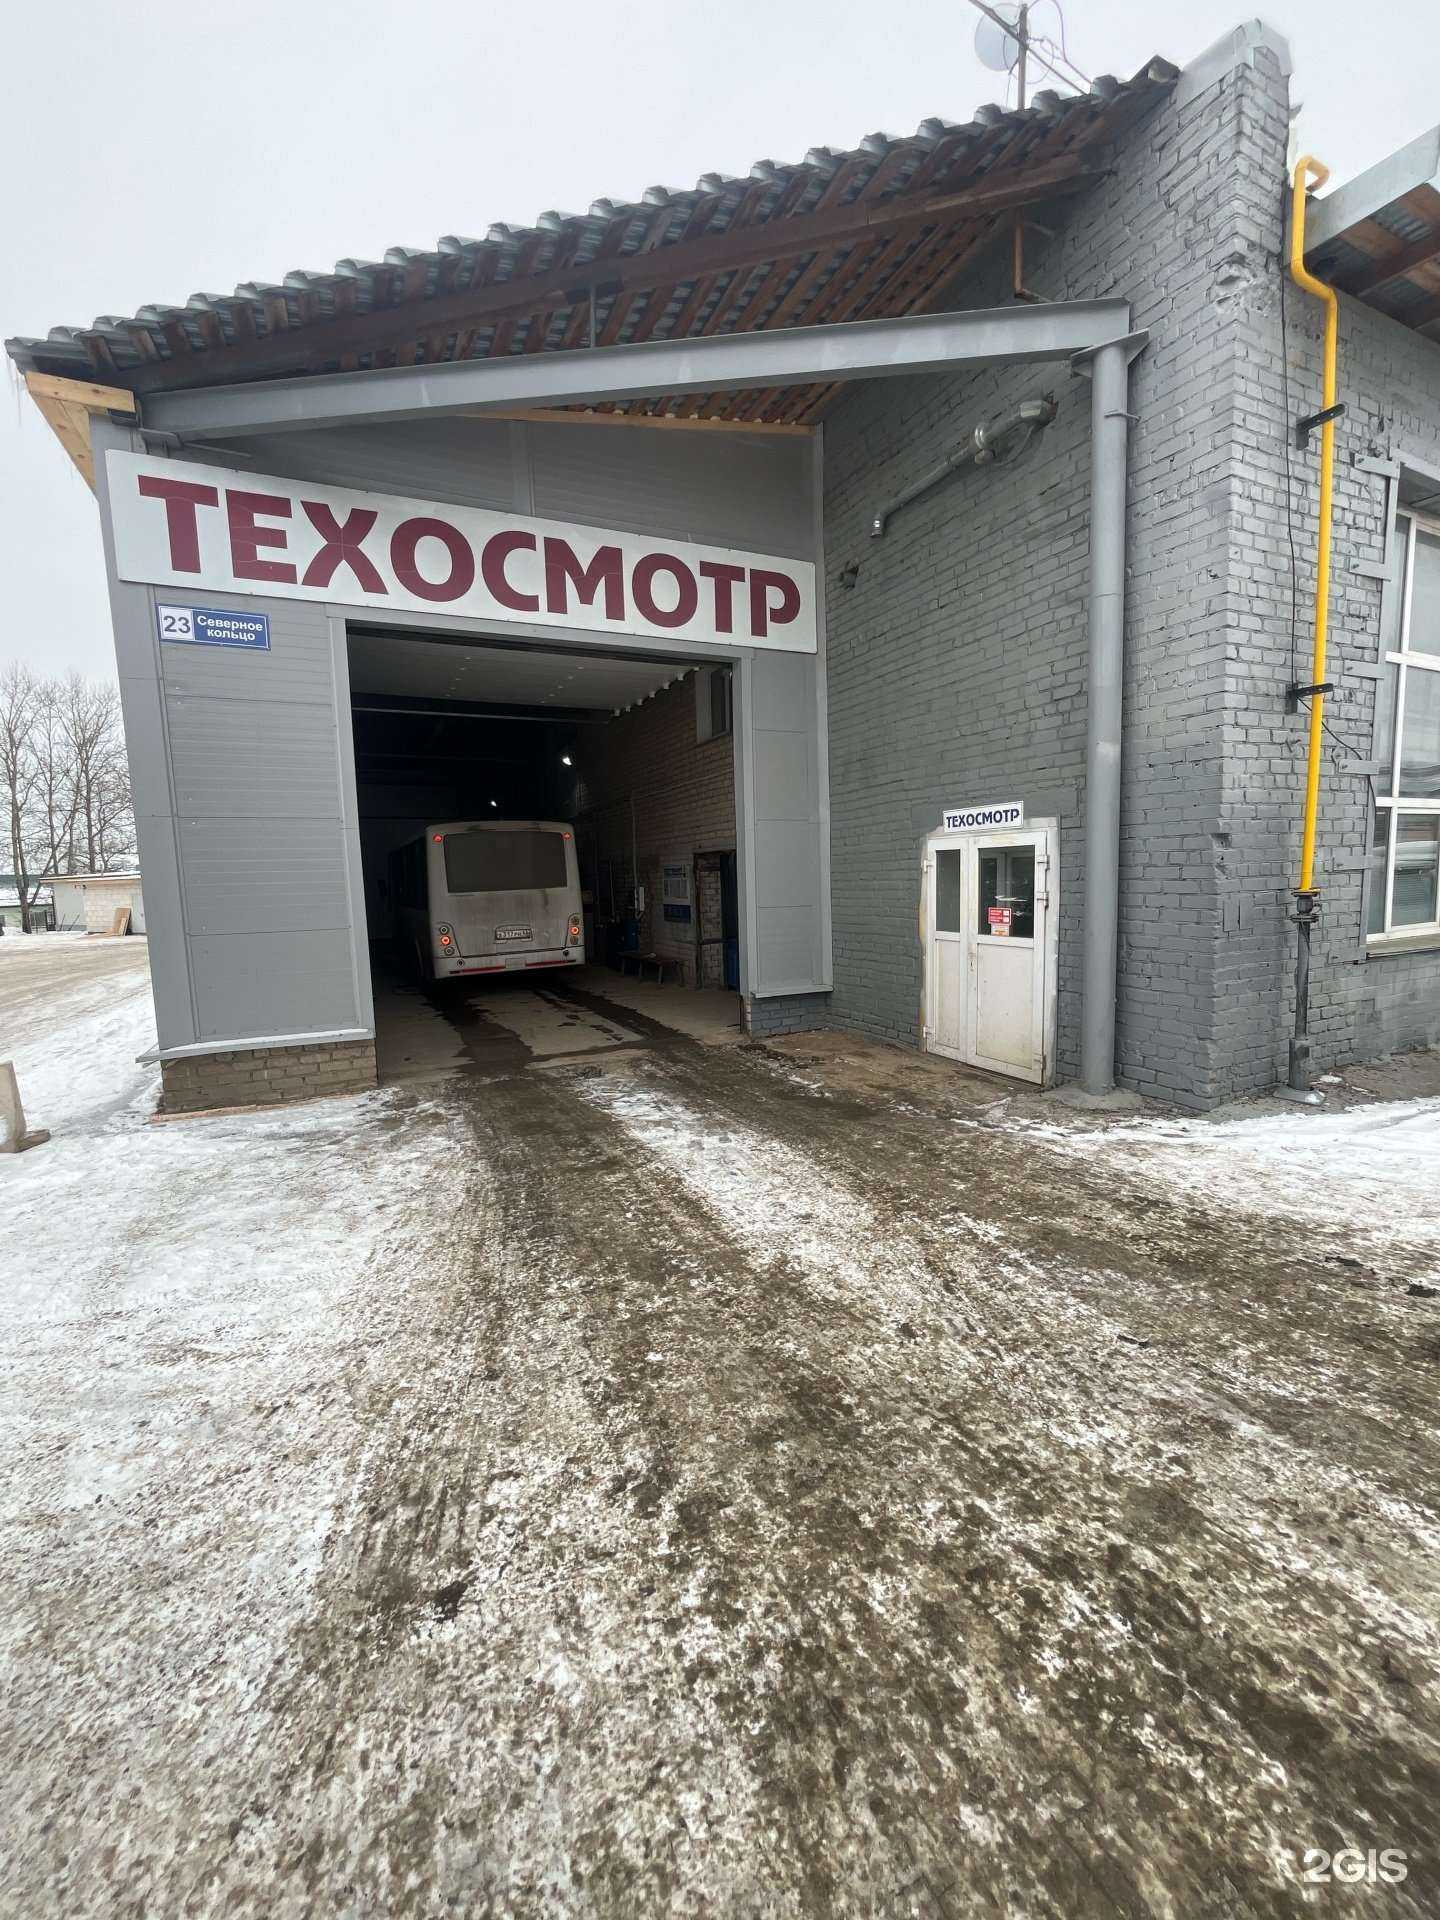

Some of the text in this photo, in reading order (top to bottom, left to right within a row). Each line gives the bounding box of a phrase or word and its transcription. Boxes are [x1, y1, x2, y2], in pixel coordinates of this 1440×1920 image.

[138, 475, 801, 637] ТЕХОСМОТР
[163, 615, 191, 634] 23
[197, 615, 263, 632] Северное
[207, 628, 256, 641] кольцо
[946, 808, 1020, 829] ТЕХОСМОТР
